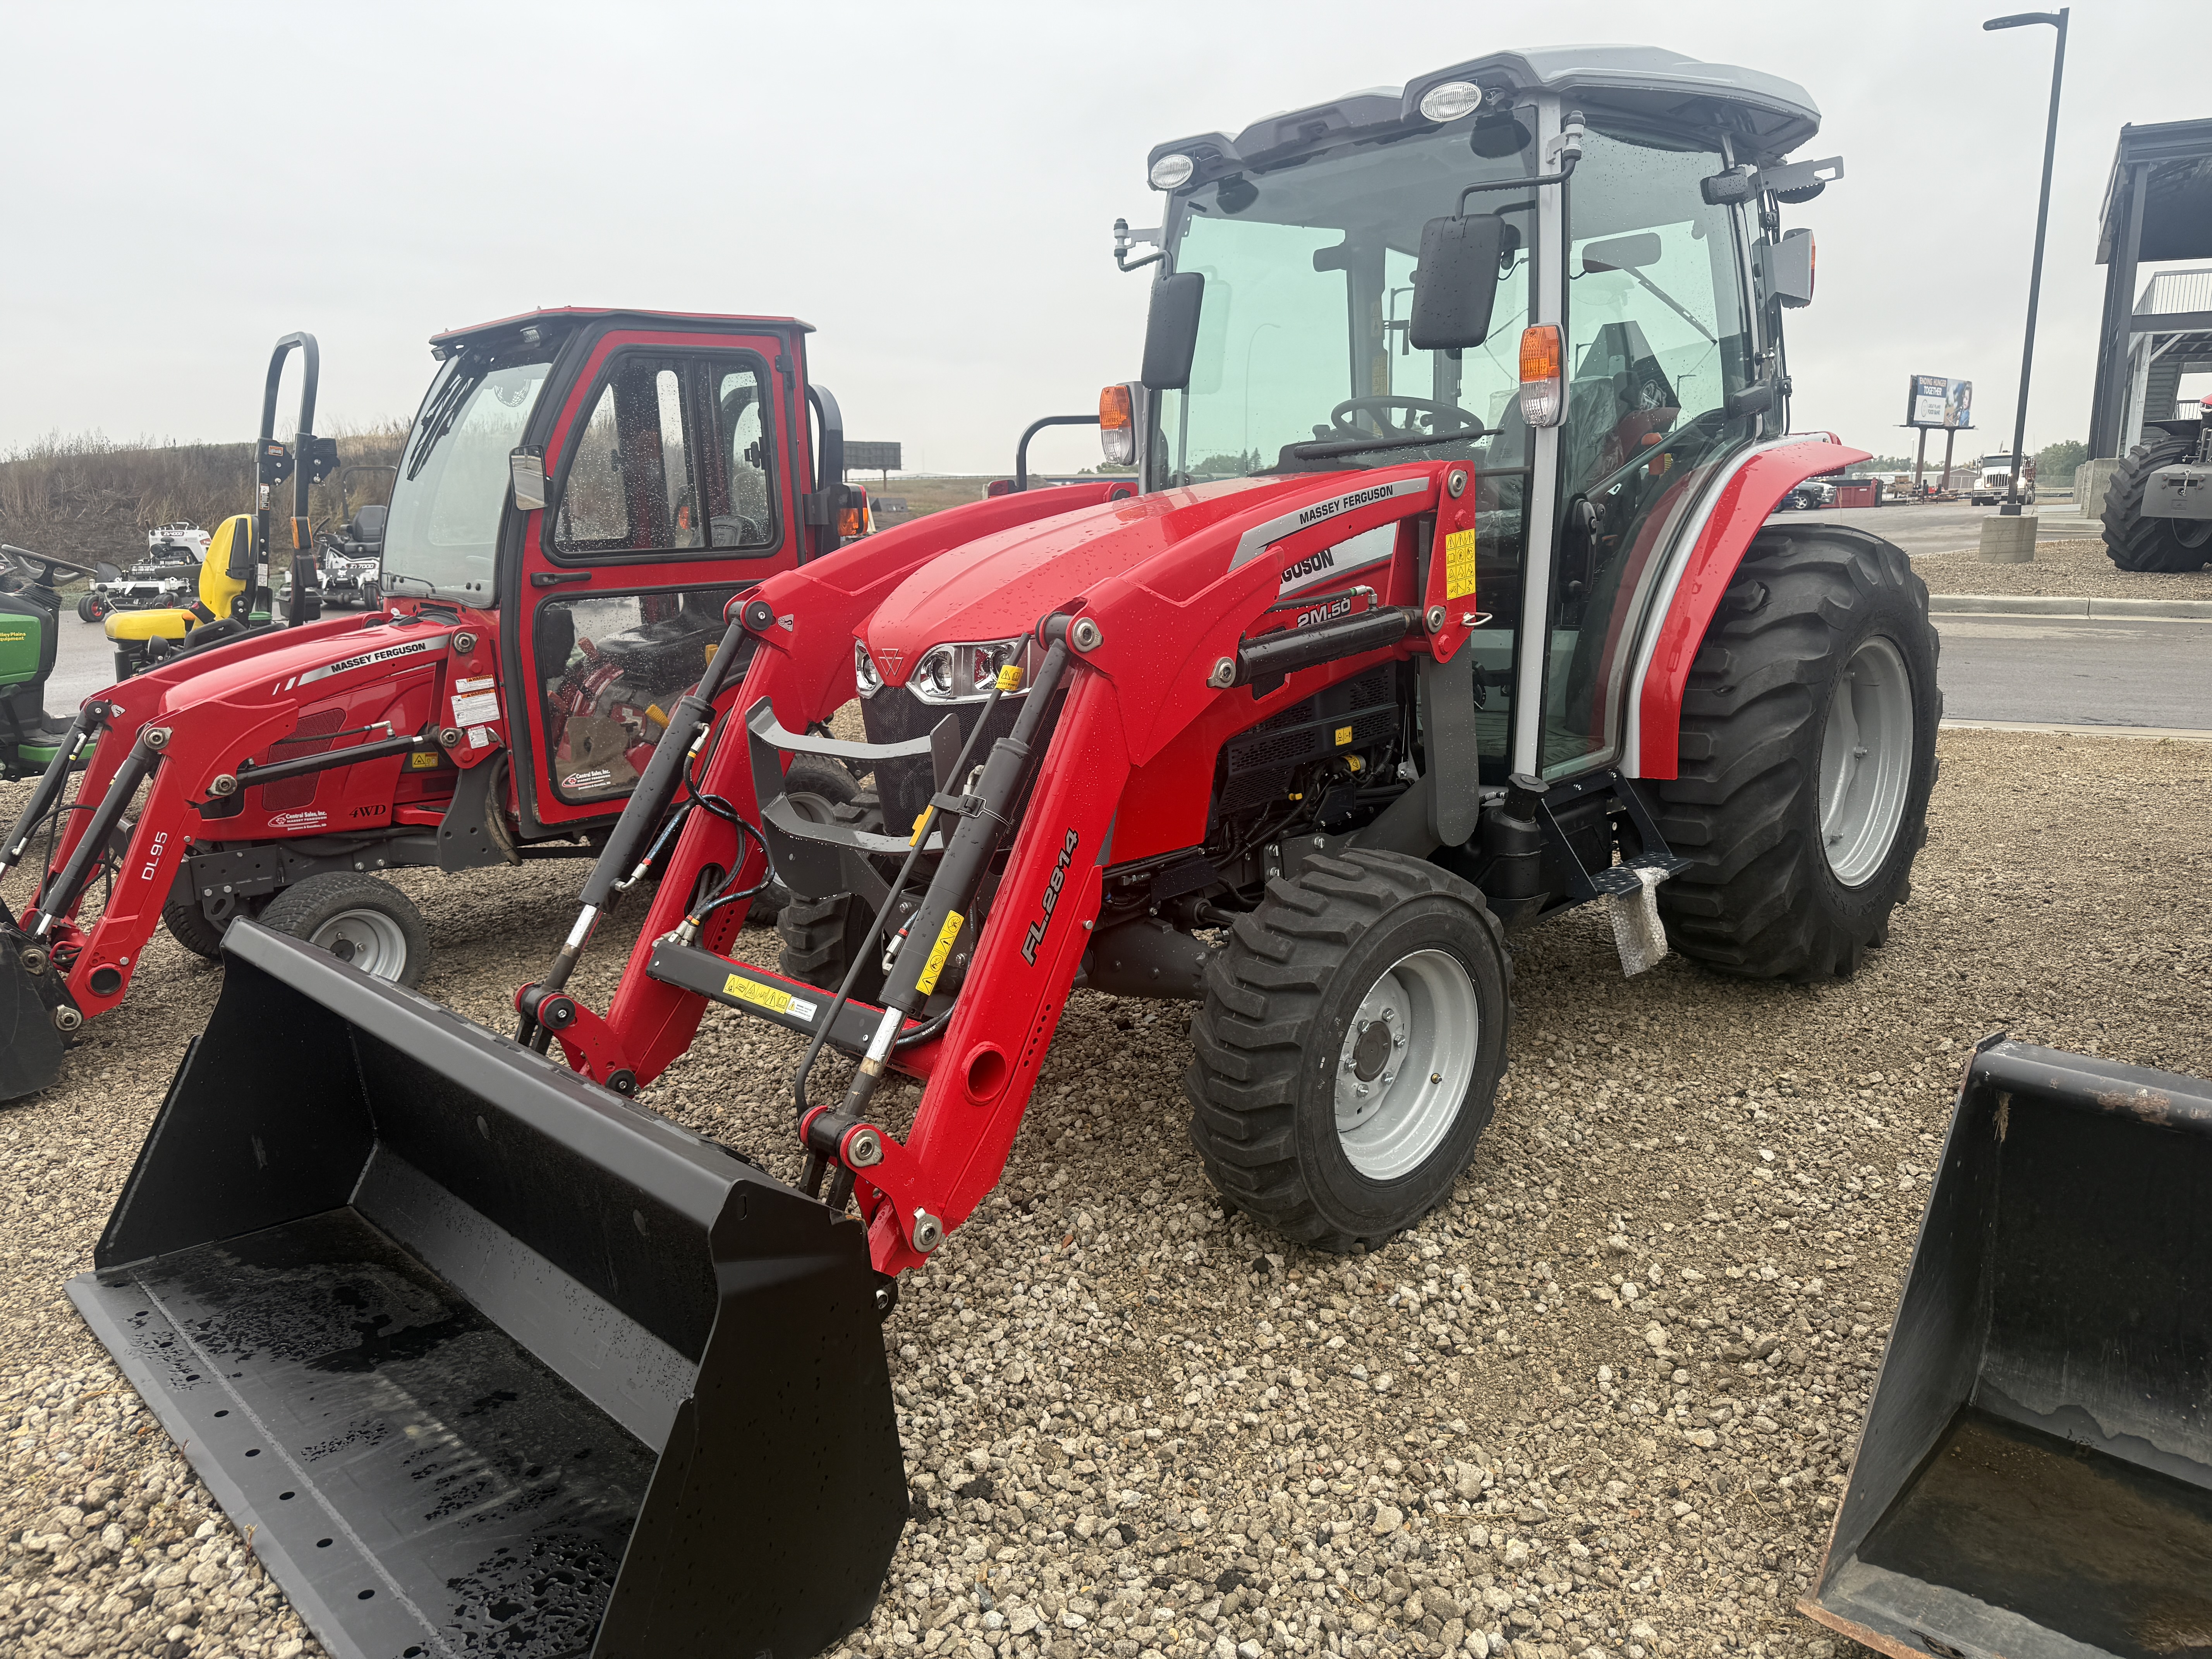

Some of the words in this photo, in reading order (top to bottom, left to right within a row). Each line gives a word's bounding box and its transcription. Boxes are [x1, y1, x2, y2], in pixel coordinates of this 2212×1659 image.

[1919, 377, 1933, 385] ENDING
[1933, 379, 1947, 387] HUNGER
[1923, 386, 1942, 396] TOGETHER
[1299, 500, 1340, 525] MASSEY
[1343, 485, 1394, 509] FERGUSON
[1280, 548, 1334, 584] GUSON
[1297, 599, 1351, 627] 2M.50
[331, 655, 371, 673] MASSEY
[374, 642, 426, 661] FERGUSON
[349, 804, 386, 818] 4WD
[141, 831, 168, 881] DL95
[1020, 827, 1079, 967] FL.2814
